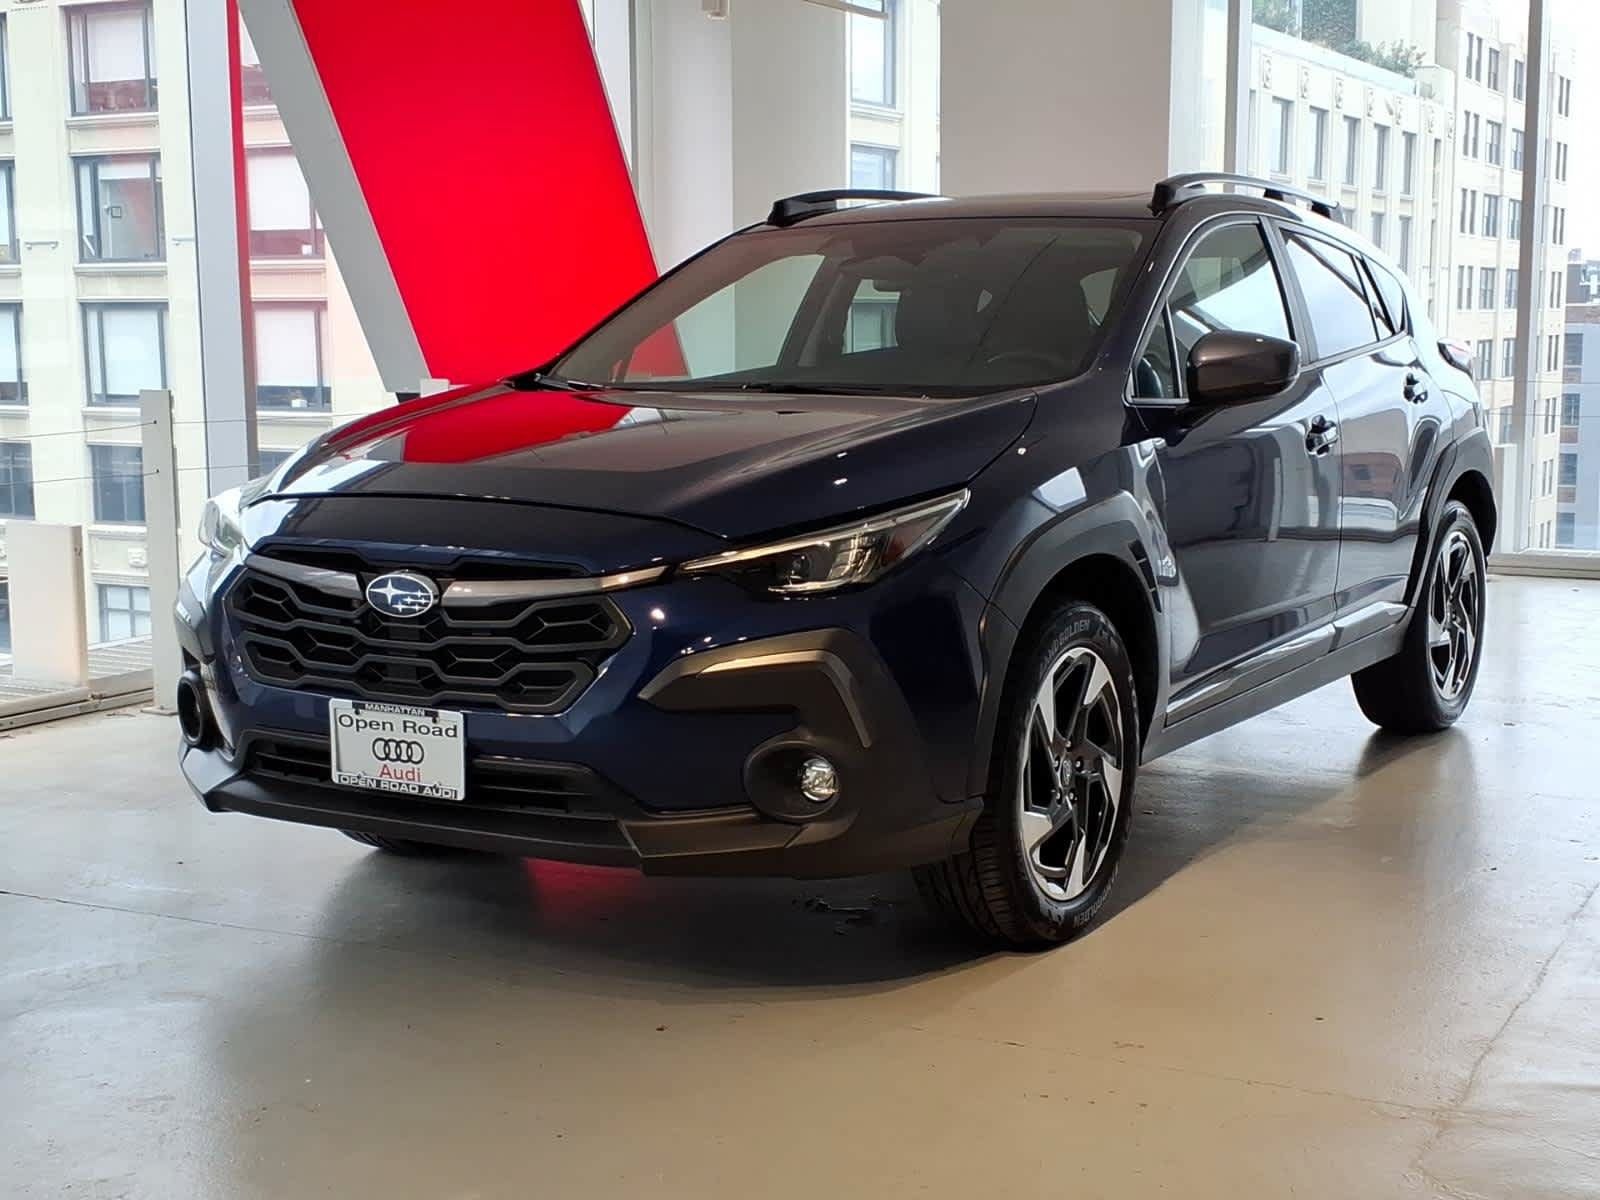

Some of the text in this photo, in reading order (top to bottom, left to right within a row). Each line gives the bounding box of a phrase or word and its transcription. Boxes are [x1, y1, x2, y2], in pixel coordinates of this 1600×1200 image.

[364, 703, 425, 717] MANHATTAN
[338, 714, 458, 738] Open Road
[379, 764, 421, 782] Audi
[340, 774, 456, 799] OPEN ROAD AUDI
